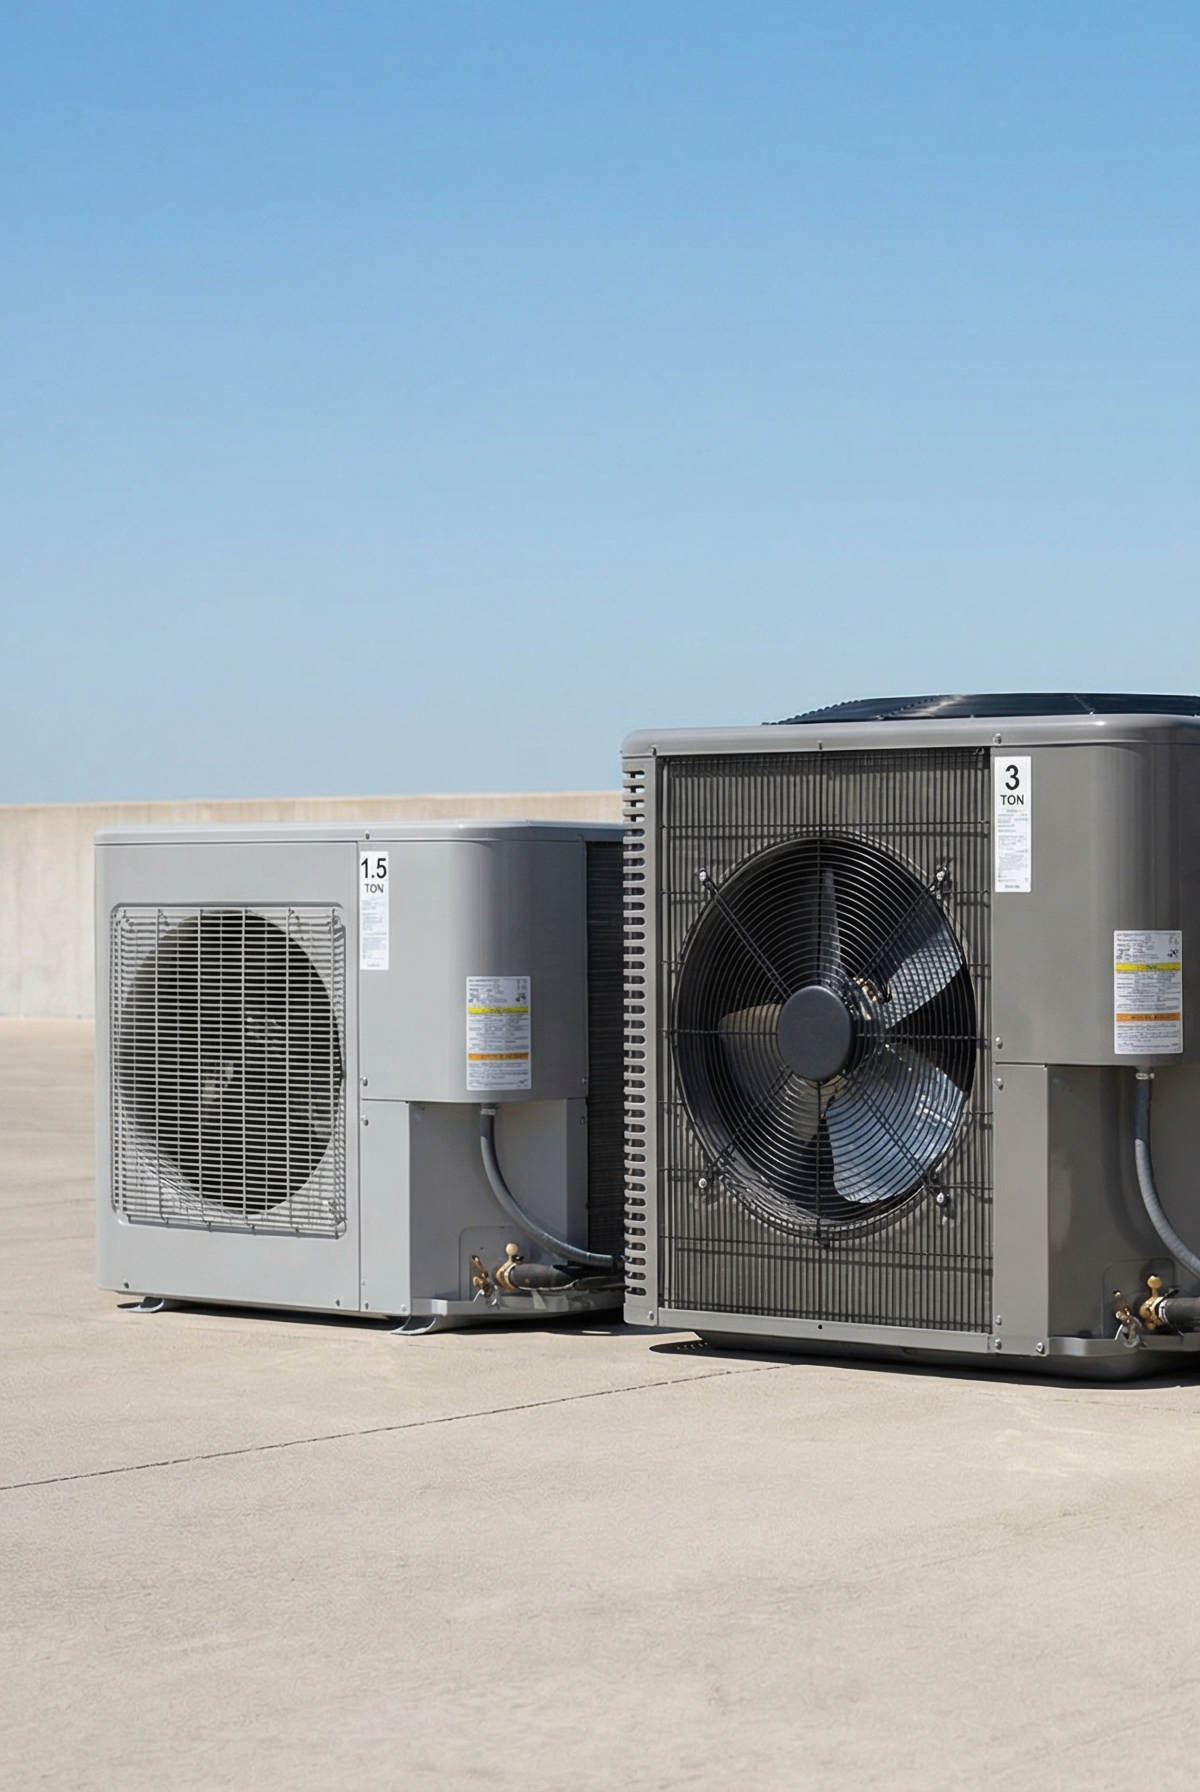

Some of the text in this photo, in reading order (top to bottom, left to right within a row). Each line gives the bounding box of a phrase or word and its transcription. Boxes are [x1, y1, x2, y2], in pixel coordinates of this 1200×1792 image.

[1005, 764, 1020, 790] 3
[1000, 794, 1024, 805] TON
[361, 858, 387, 879] 1.5
[364, 884, 384, 893] TON
